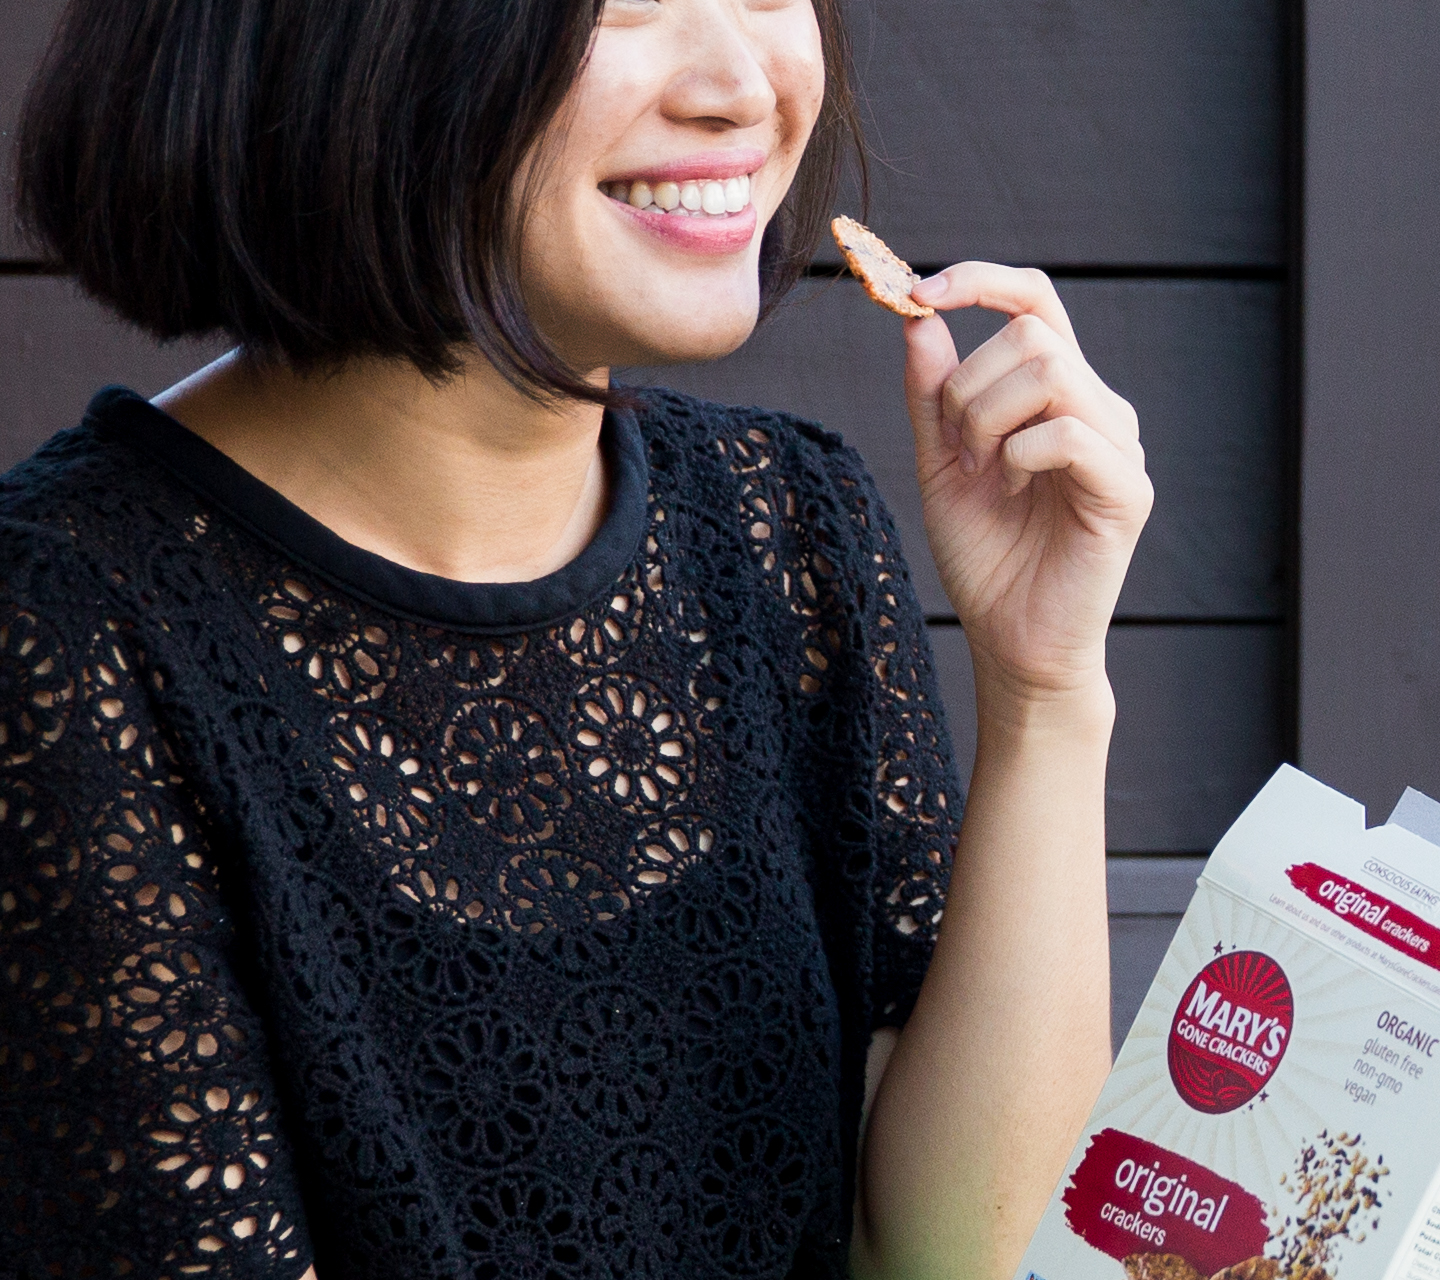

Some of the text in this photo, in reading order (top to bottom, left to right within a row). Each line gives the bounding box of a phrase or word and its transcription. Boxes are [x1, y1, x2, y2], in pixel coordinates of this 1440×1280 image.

[1362, 858, 1412, 891] CONSCIOUS
[1318, 878, 1389, 927] original
[1381, 917, 1430, 953] crackers
[1184, 980, 1286, 1058] MARY'S
[1377, 1010, 1440, 1058] ORGANIC
[1177, 1018, 1271, 1076] GONE CRACKERS
[1362, 1036, 1424, 1080] gluten free
[1344, 1078, 1378, 1106] vegan
[1354, 1057, 1402, 1095] non-gmo
[1114, 1158, 1228, 1232] original
[1100, 1202, 1166, 1246] crackers
